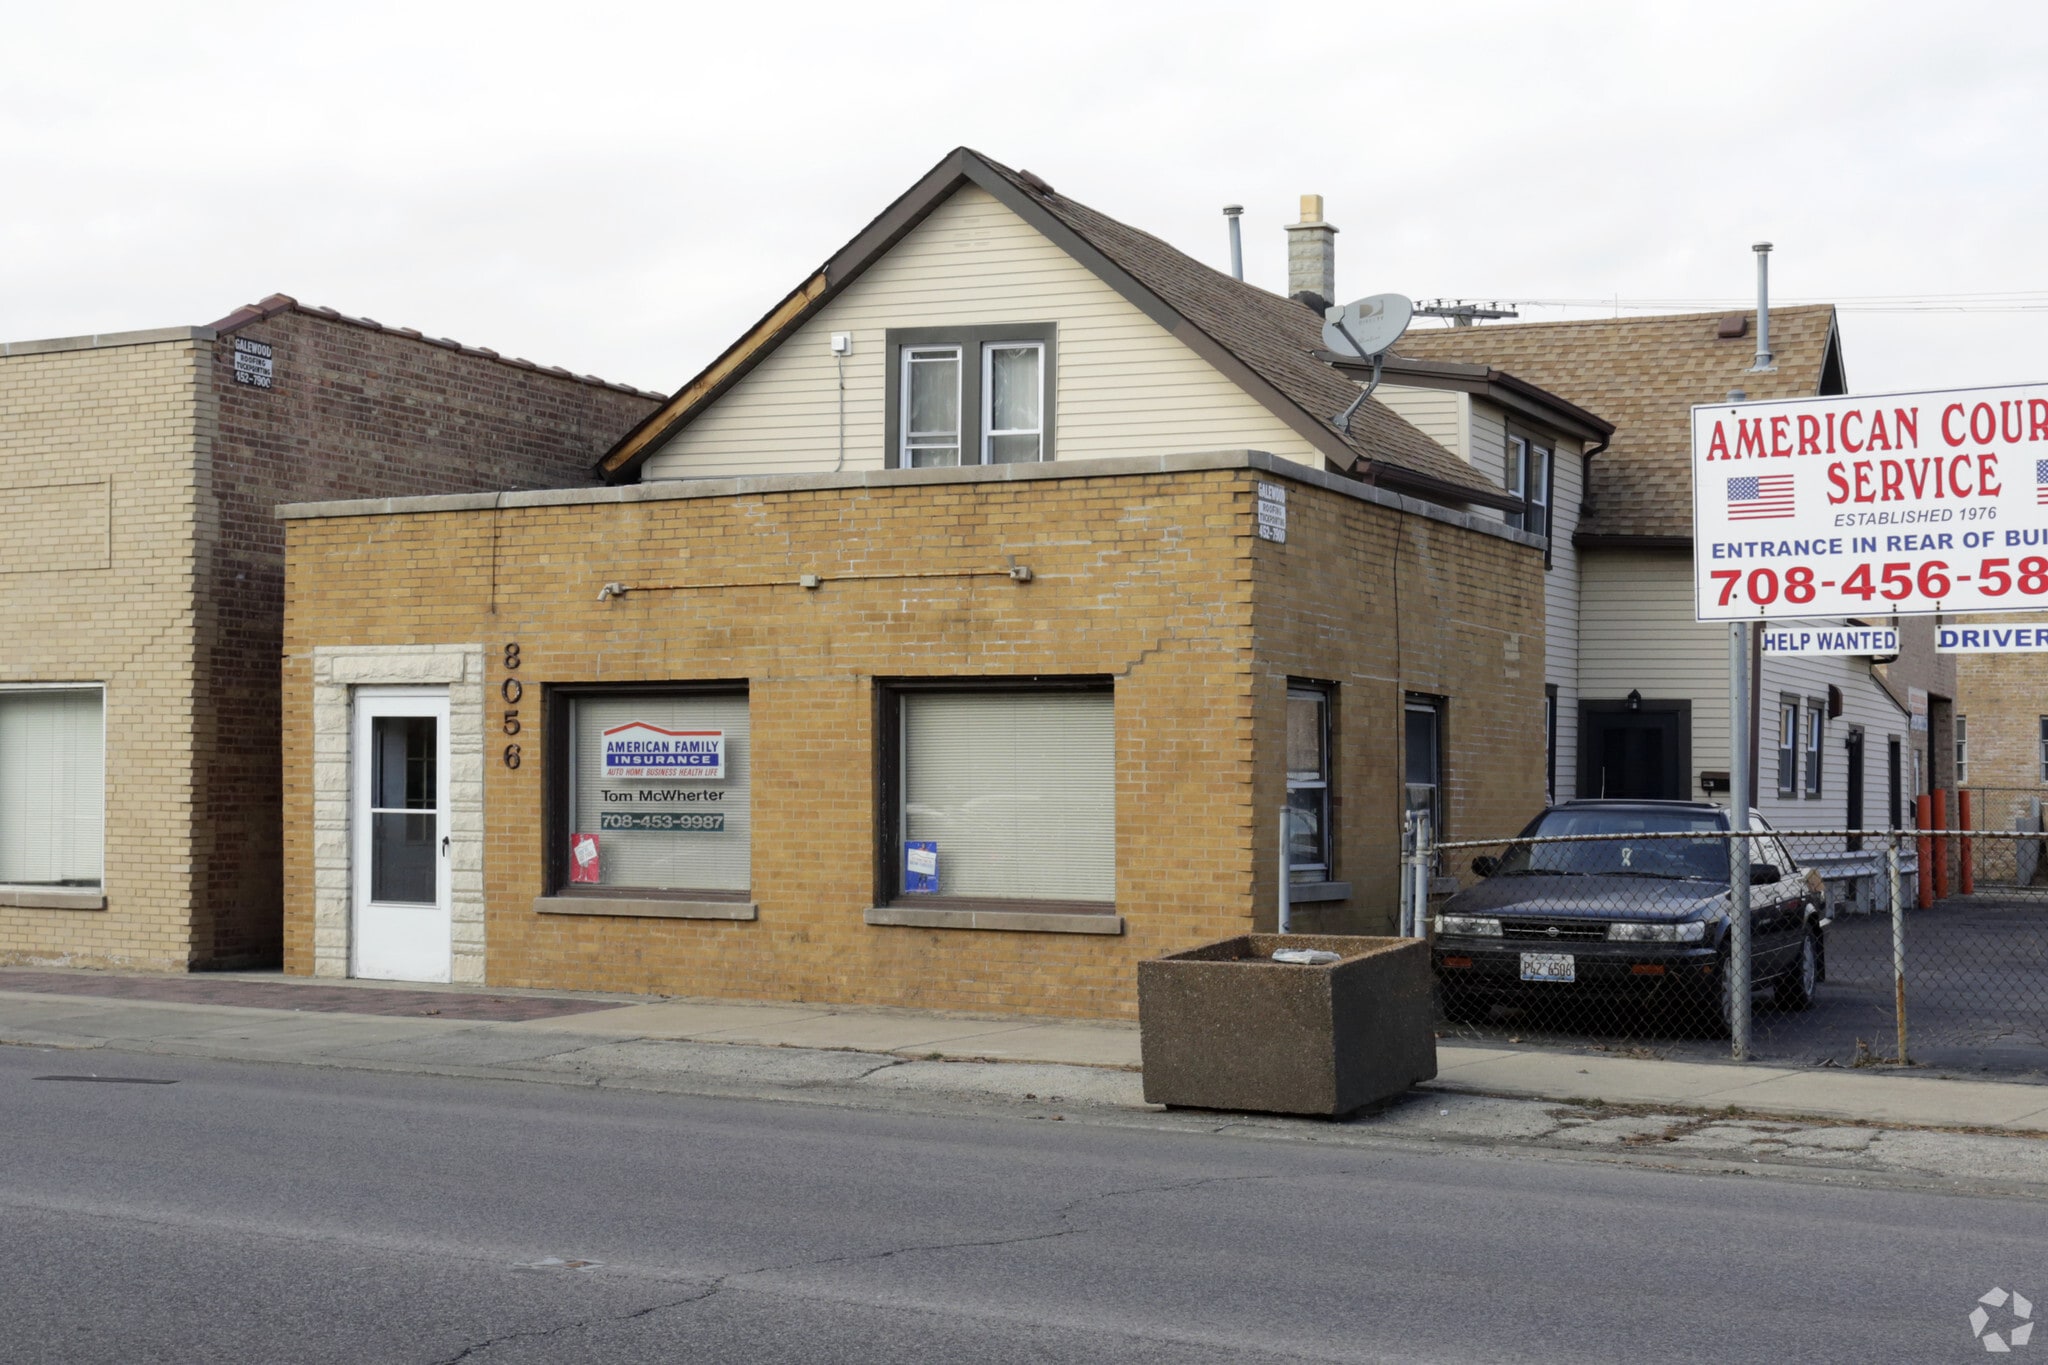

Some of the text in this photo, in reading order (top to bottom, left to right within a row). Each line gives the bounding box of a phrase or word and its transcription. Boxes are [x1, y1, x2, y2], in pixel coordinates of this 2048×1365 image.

[235, 338, 271, 358] GALEWOOD
[1706, 398, 2048, 461] AMERICAN COUR
[1826, 452, 2002, 506] SERVICE
[1834, 506, 1997, 527] ESTABLISHED 1976
[1712, 538, 1843, 559] ENTRANCE
[1852, 536, 1877, 553] IN
[1887, 533, 1954, 552] REAR
[1963, 531, 1995, 549] OF
[1710, 556, 2048, 606] 708-456-58
[1763, 631, 1896, 651] HELP WANTED
[1940, 628, 2048, 648] DRIVER
[501, 642, 523, 770] 8056
[607, 741, 719, 753] AMERICAN FAMILY
[615, 755, 711, 764] INSURANCE
[607, 768, 718, 776] AUTO HOME BUSINESS HEALTH LIFE
[601, 790, 725, 802] Tom McWherter
[601, 814, 724, 829] 708-453-9987
